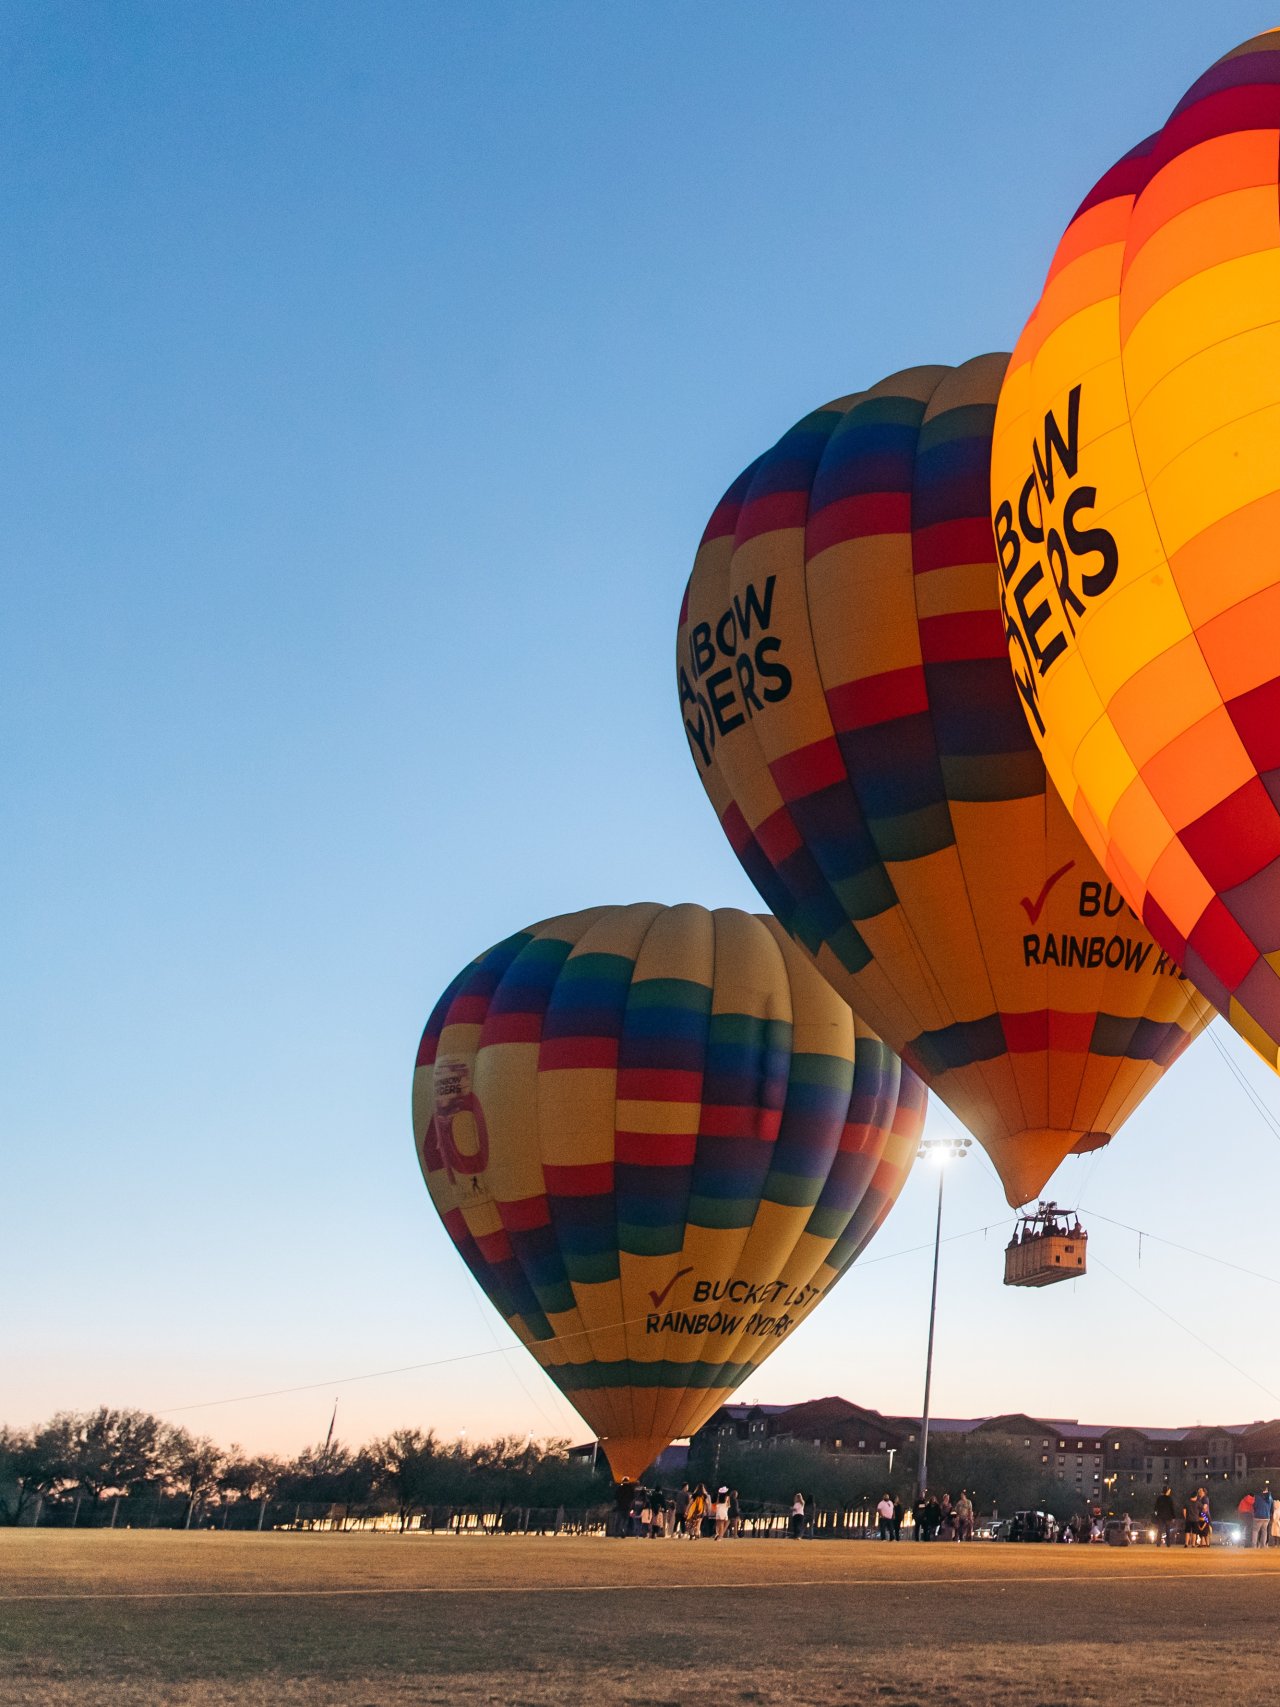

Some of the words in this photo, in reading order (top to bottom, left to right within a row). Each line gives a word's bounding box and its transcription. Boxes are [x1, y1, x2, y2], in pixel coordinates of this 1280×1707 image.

[1022, 933, 1154, 974] RAINBOW
[693, 1277, 789, 1305] BUCKET
[784, 1283, 820, 1307] LST
[646, 1310, 744, 1336] RAINBOW
